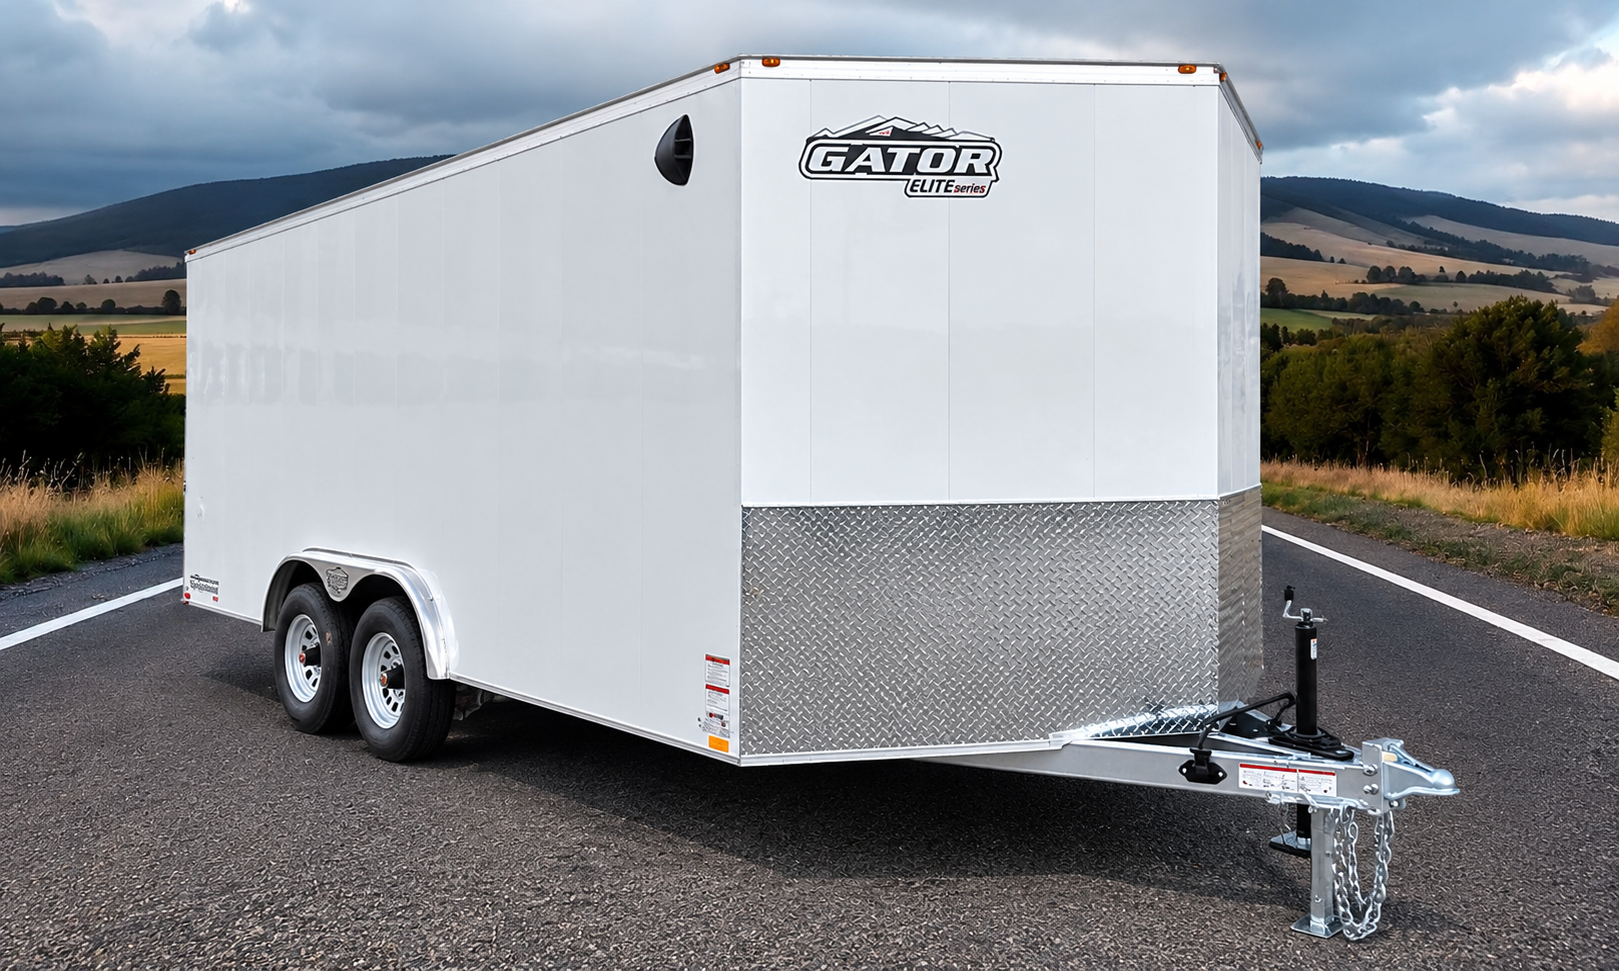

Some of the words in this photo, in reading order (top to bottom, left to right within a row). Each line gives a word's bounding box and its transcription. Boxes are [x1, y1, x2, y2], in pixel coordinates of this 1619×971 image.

[808, 146, 993, 174] GATOR
[910, 179, 955, 193] ELITE
[954, 183, 986, 194] series
